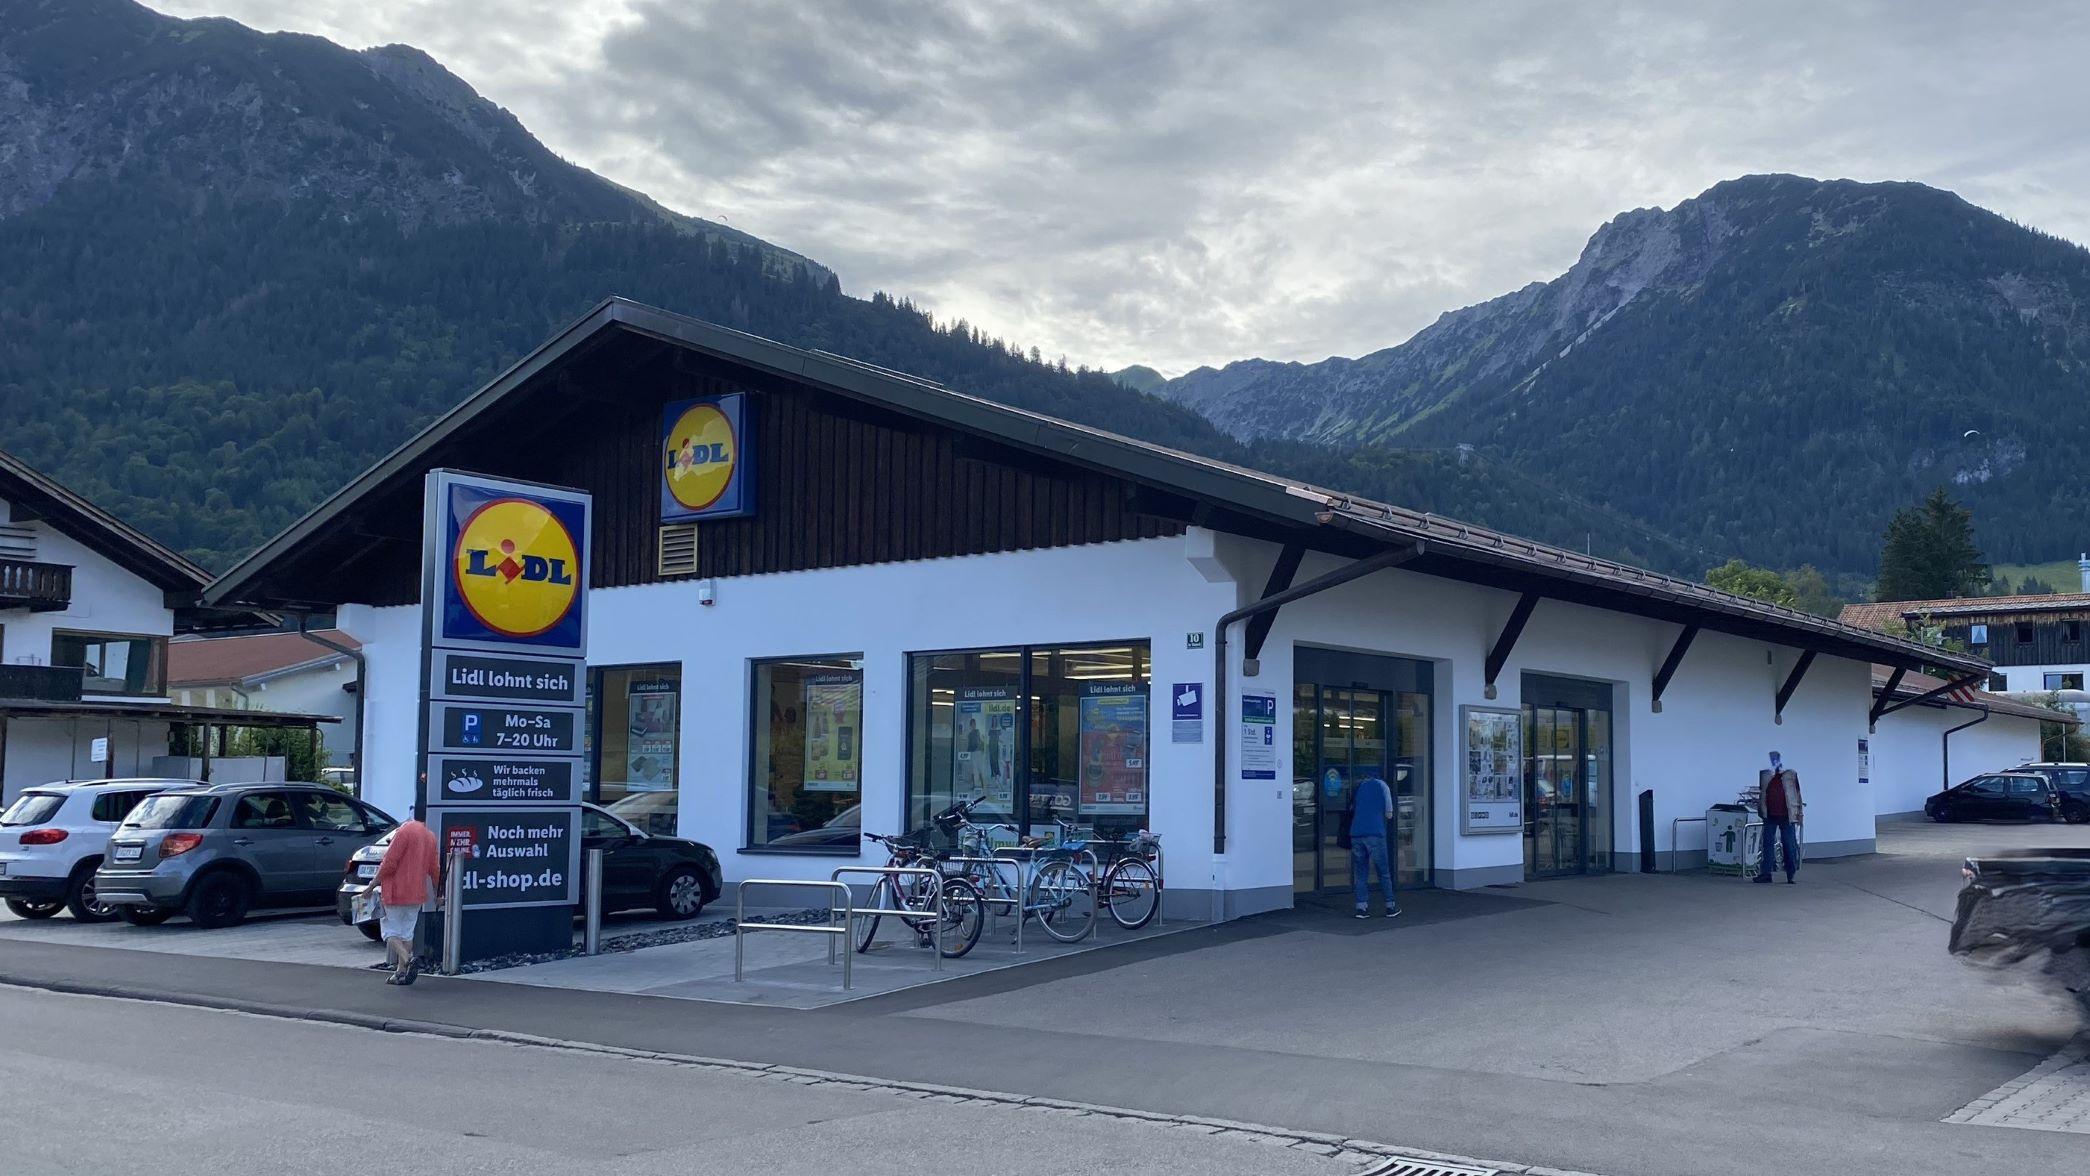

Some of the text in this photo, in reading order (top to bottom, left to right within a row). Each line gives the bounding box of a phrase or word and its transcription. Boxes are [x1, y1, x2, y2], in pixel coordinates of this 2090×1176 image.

[668, 438, 729, 472] LIDL
[466, 539, 571, 585] LIDL
[1190, 633, 1199, 643] 10
[452, 668, 568, 690] Lidl lohnt sich
[1090, 684, 1136, 693] Lidl lohnt sich
[1267, 699, 1274, 715] P
[465, 714, 477, 731] P
[533, 734, 558, 747] Uhr
[493, 765, 545, 775] Wir backen
[493, 777, 538, 786] mehrmals
[492, 787, 553, 799] täglich frisch
[487, 825, 564, 839] Noch mehr
[486, 843, 548, 858] Auswahl
[463, 868, 562, 892] dl-shop.de
